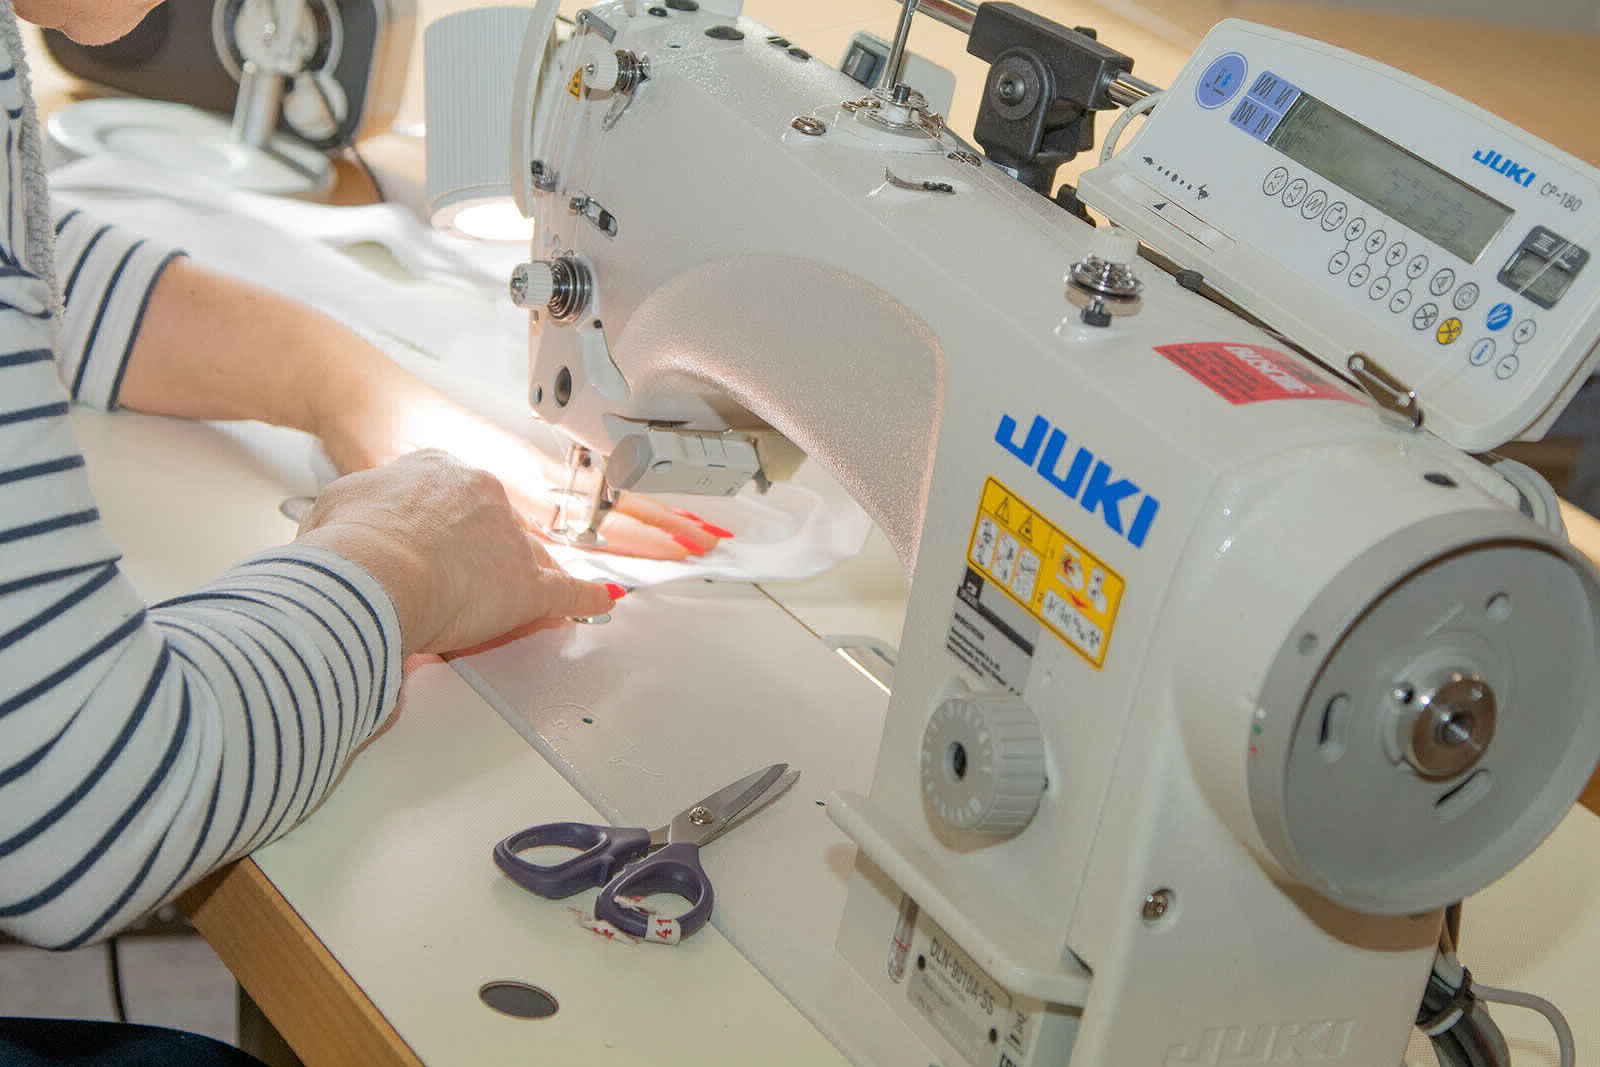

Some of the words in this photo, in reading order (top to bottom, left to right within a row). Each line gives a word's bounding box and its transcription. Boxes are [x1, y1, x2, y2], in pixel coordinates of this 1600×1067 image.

[1472, 150, 1536, 187] JUKI
[1540, 182, 1583, 212] CP-180
[994, 413, 1160, 549] JUKI
